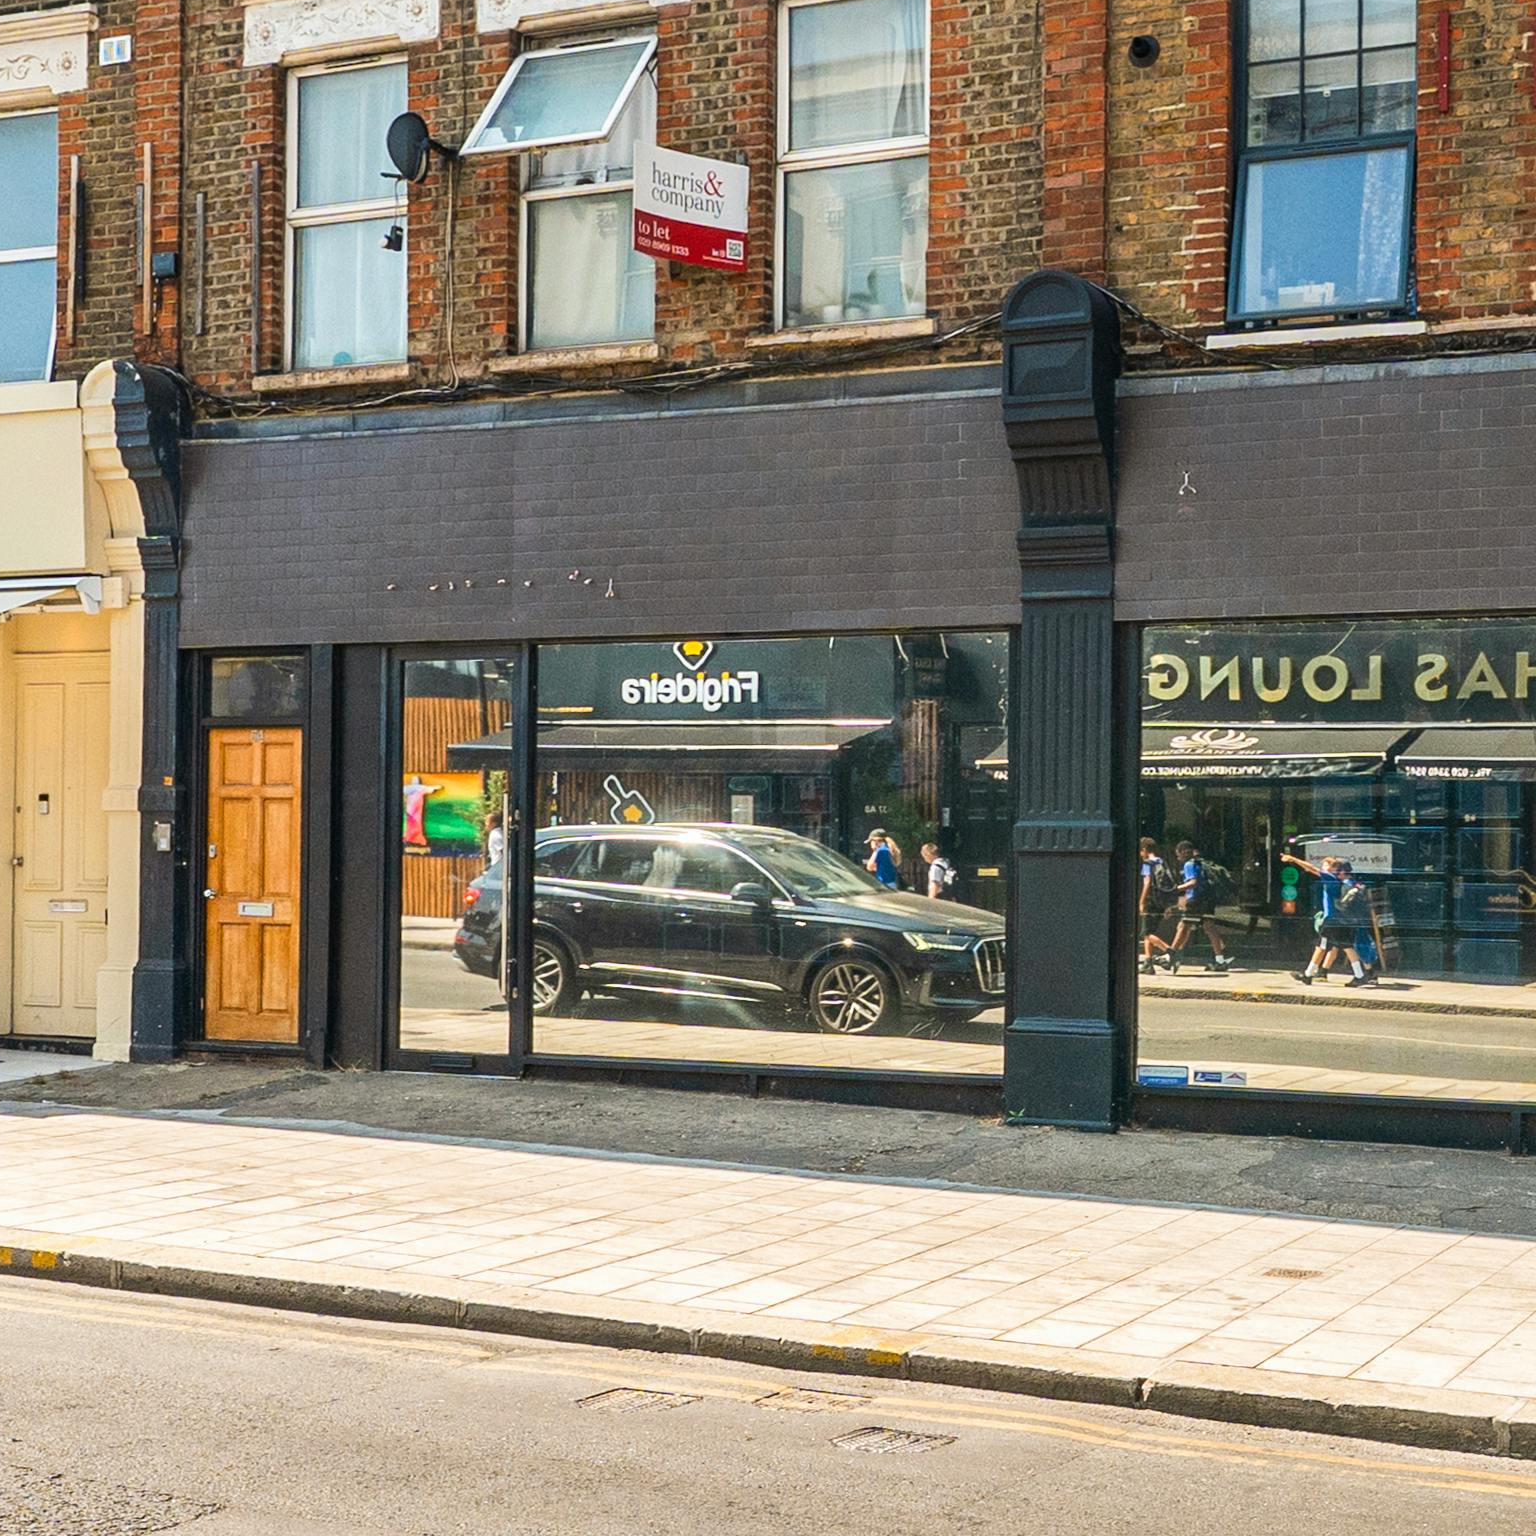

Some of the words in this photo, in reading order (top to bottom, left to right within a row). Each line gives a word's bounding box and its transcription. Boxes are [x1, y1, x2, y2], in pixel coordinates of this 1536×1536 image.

[651, 185, 725, 219] company
[638, 220, 651, 235] to
[653, 220, 671, 240] let
